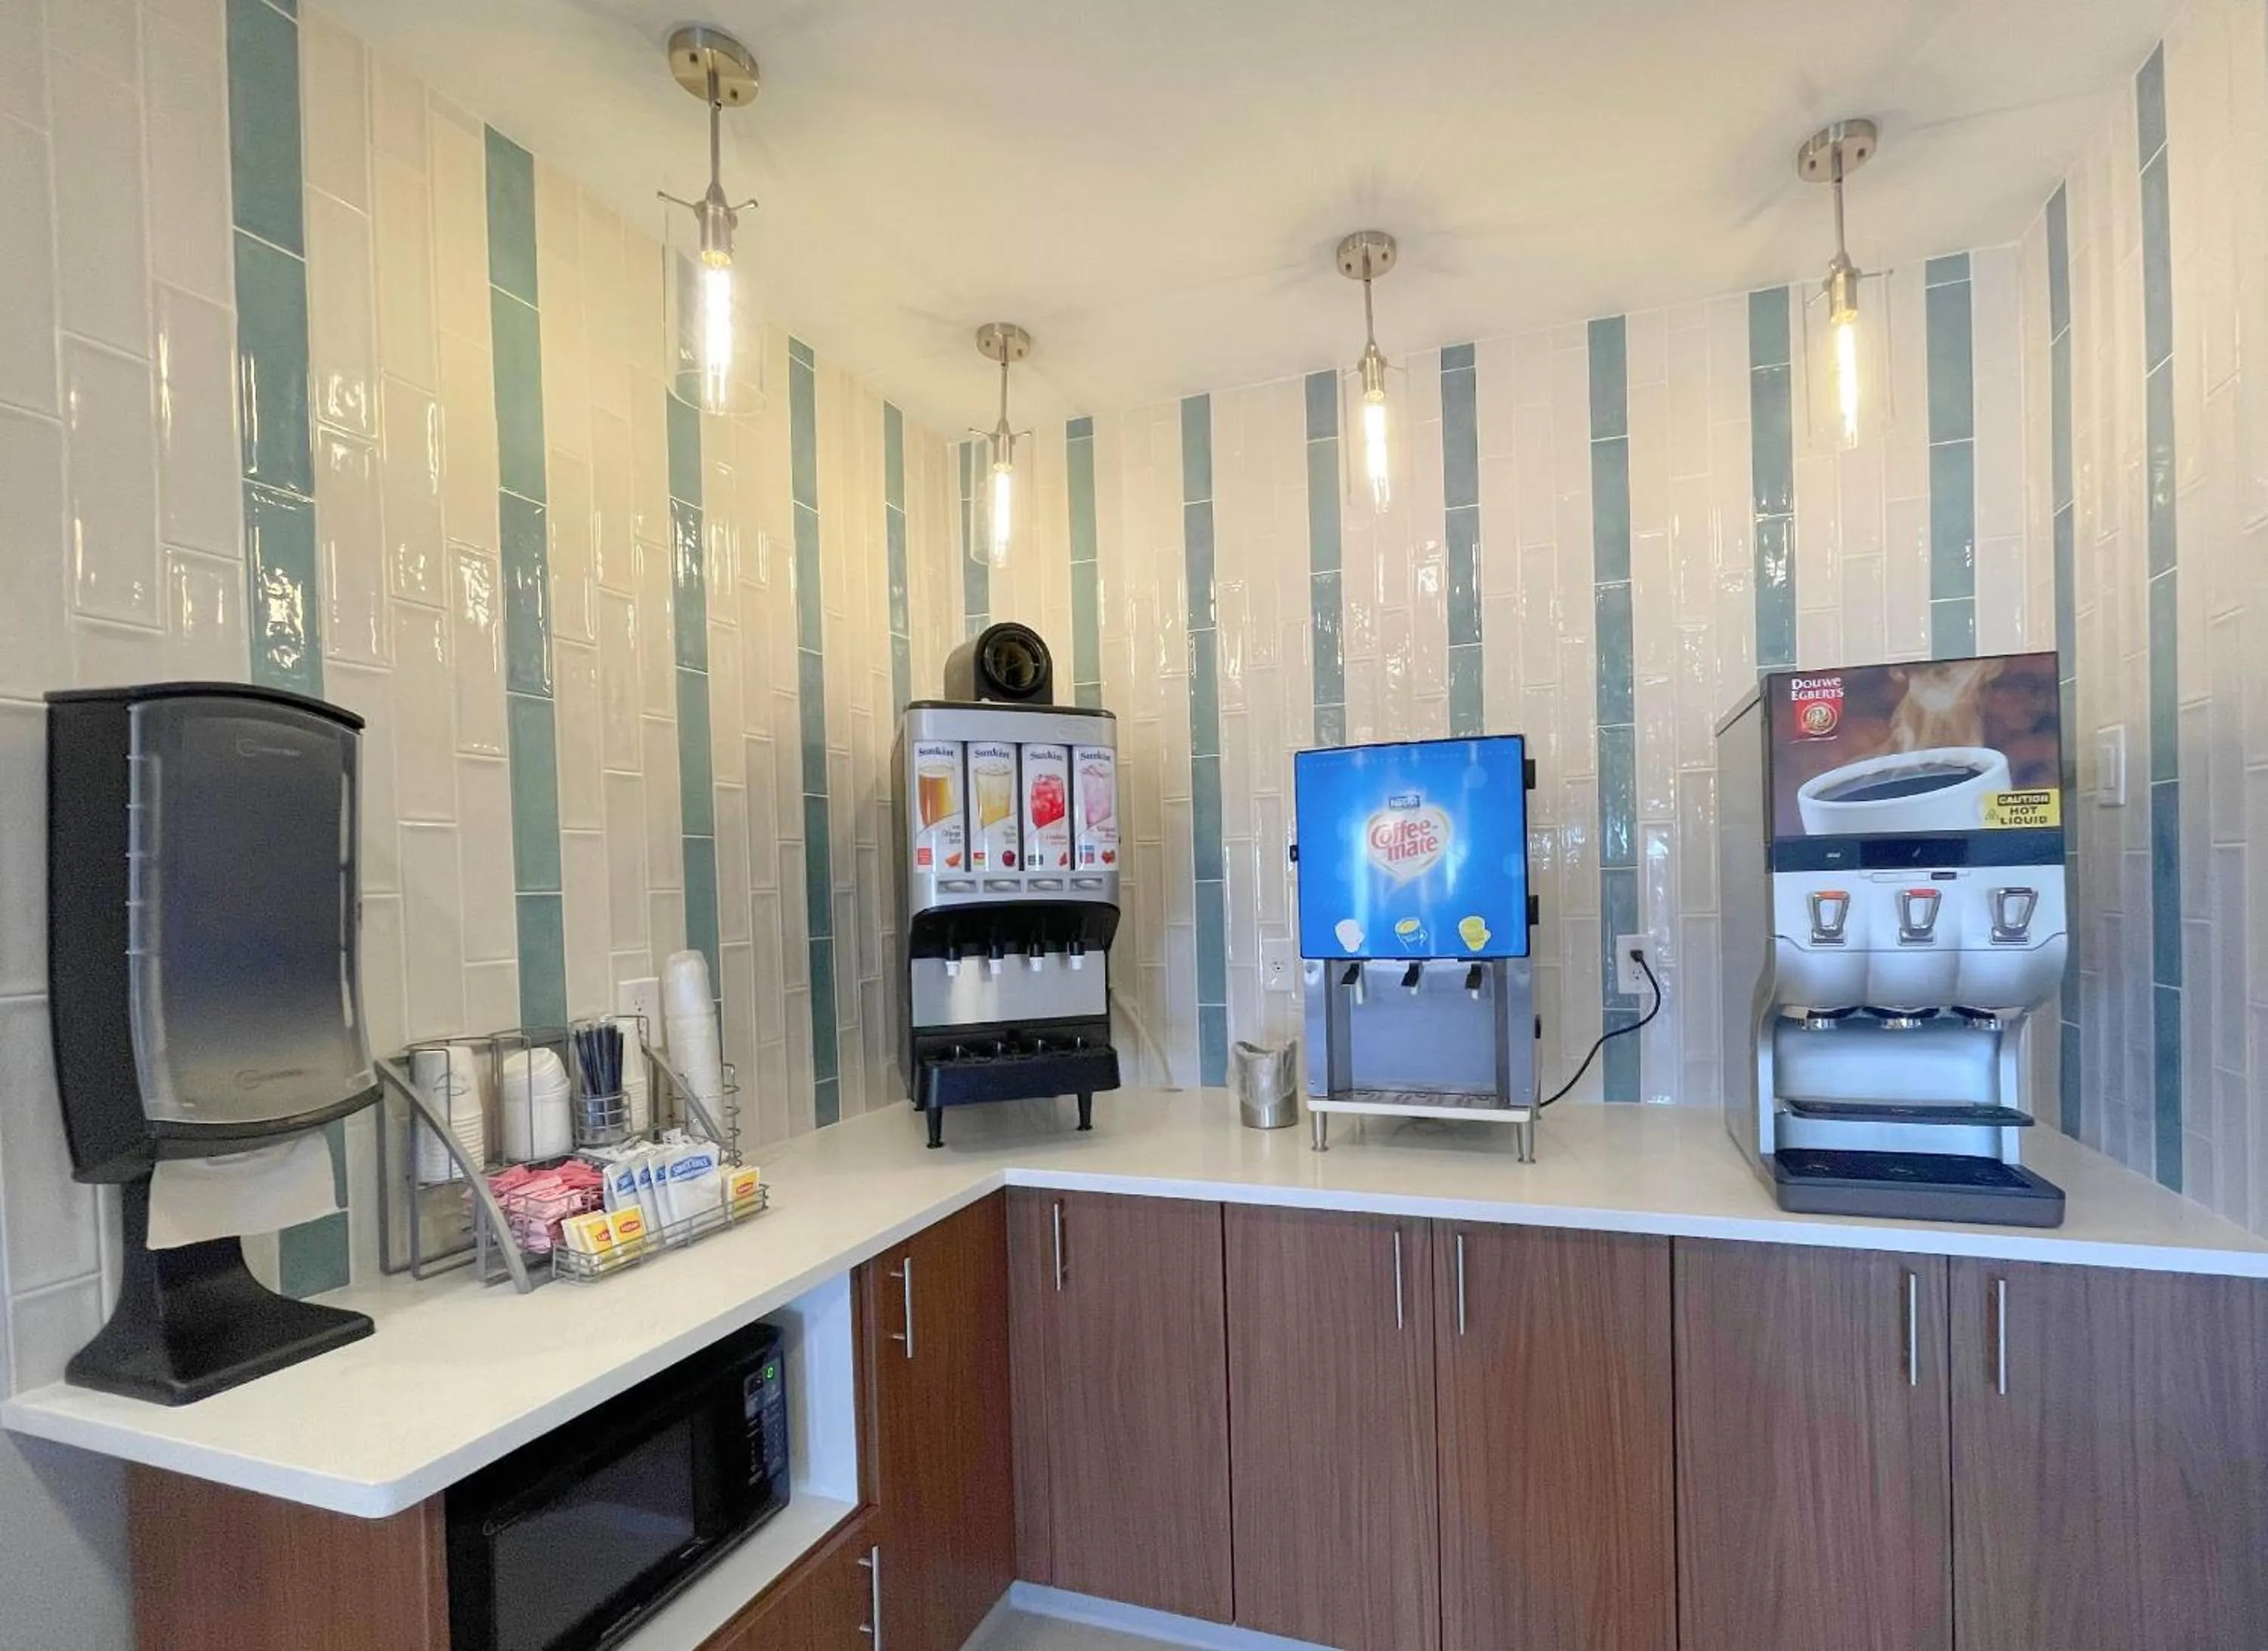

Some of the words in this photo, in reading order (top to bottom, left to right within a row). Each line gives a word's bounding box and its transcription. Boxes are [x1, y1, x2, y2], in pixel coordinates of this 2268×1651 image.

[1791, 688, 1844, 701] EGBERTS
[1998, 795, 2049, 804] CAUTION
[2010, 807, 2037, 815] HOT
[2000, 816, 2048, 825] LIQUID
[1387, 836, 1438, 860] mate
